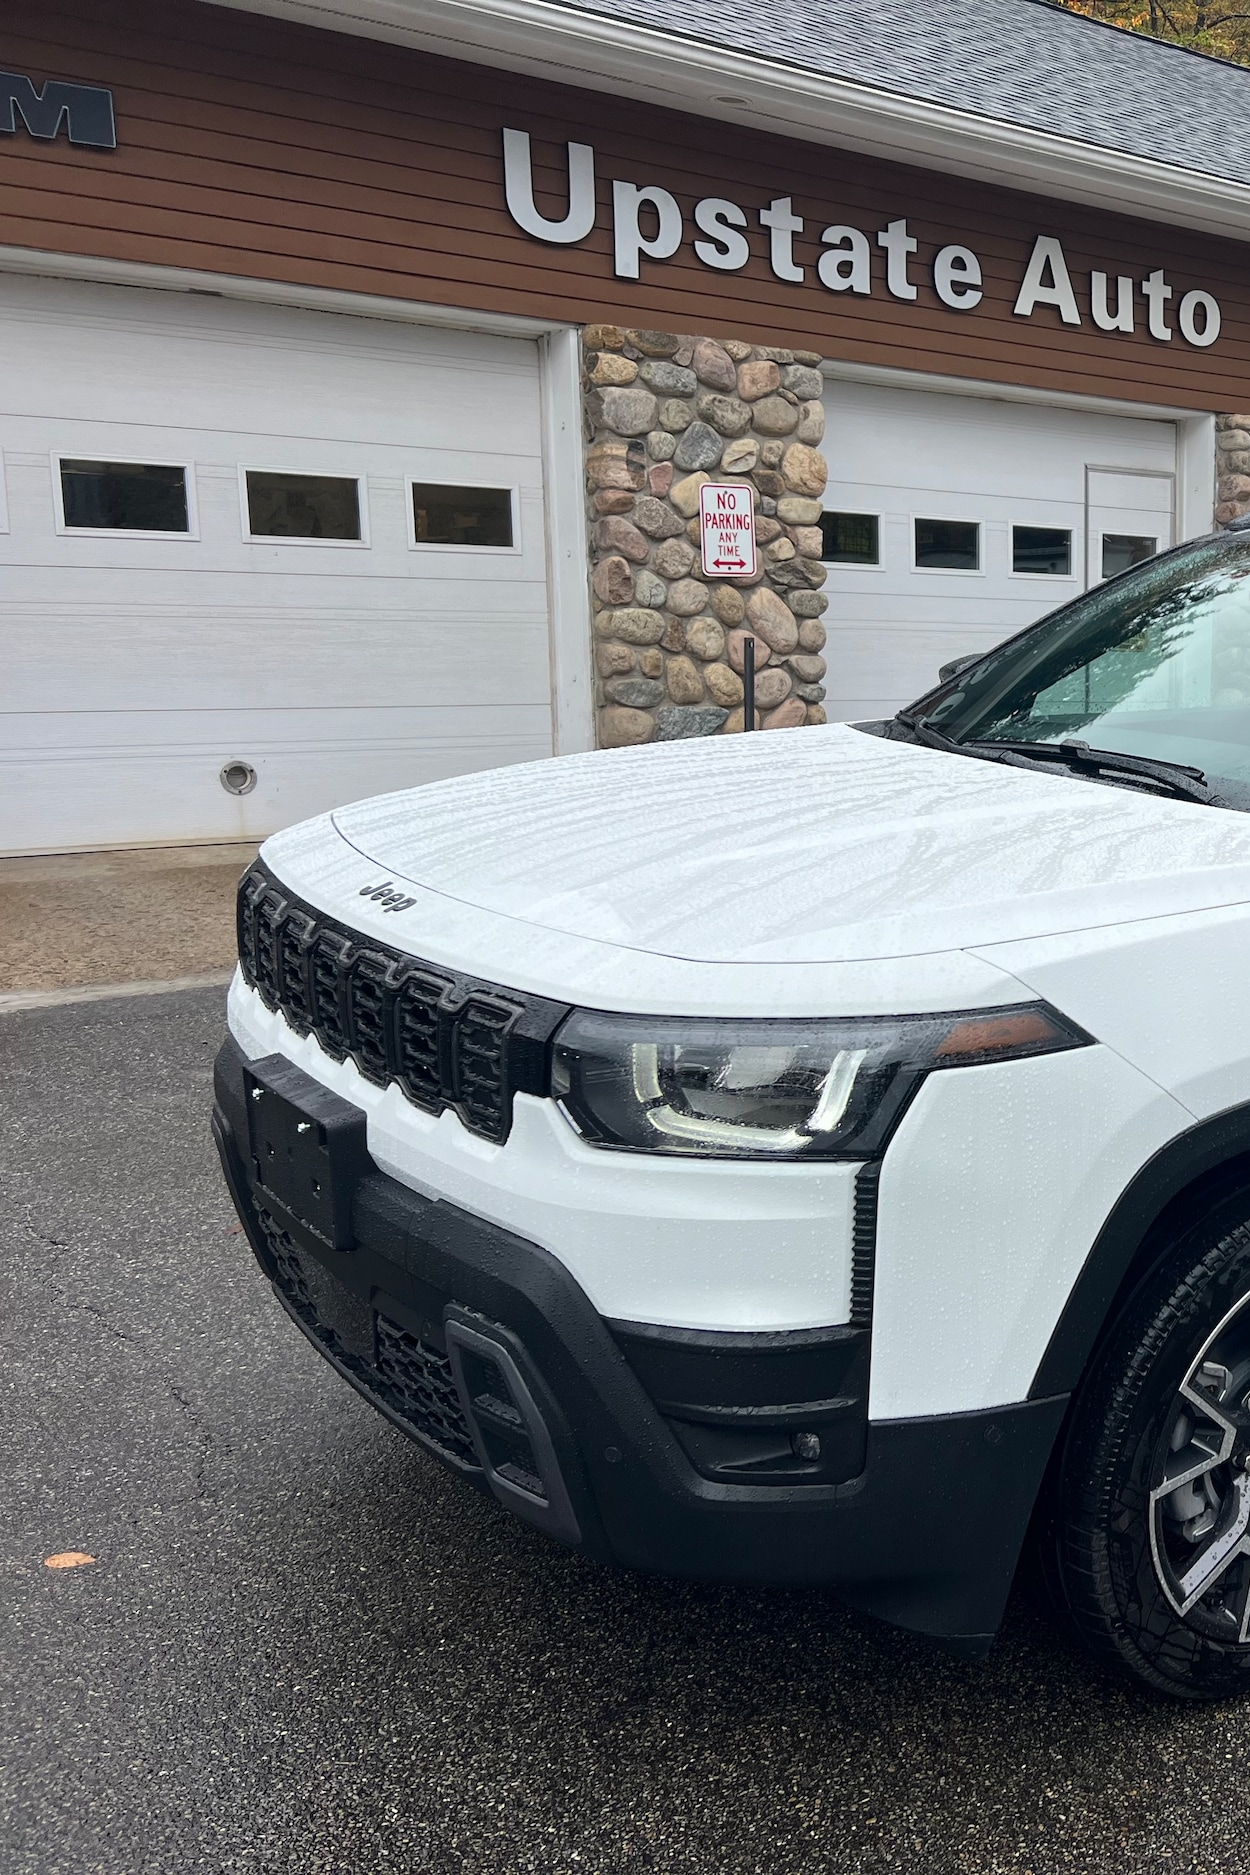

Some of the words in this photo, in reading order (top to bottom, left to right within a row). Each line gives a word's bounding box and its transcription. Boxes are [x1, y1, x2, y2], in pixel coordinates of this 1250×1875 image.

[502, 126, 984, 311] Upstate
[1013, 234, 1221, 347] Auto
[717, 493, 737, 510] NO
[705, 512, 750, 531] PARKING
[718, 532, 738, 543] ANY
[717, 545, 741, 557] TIME
[359, 881, 418, 913] Jeep
